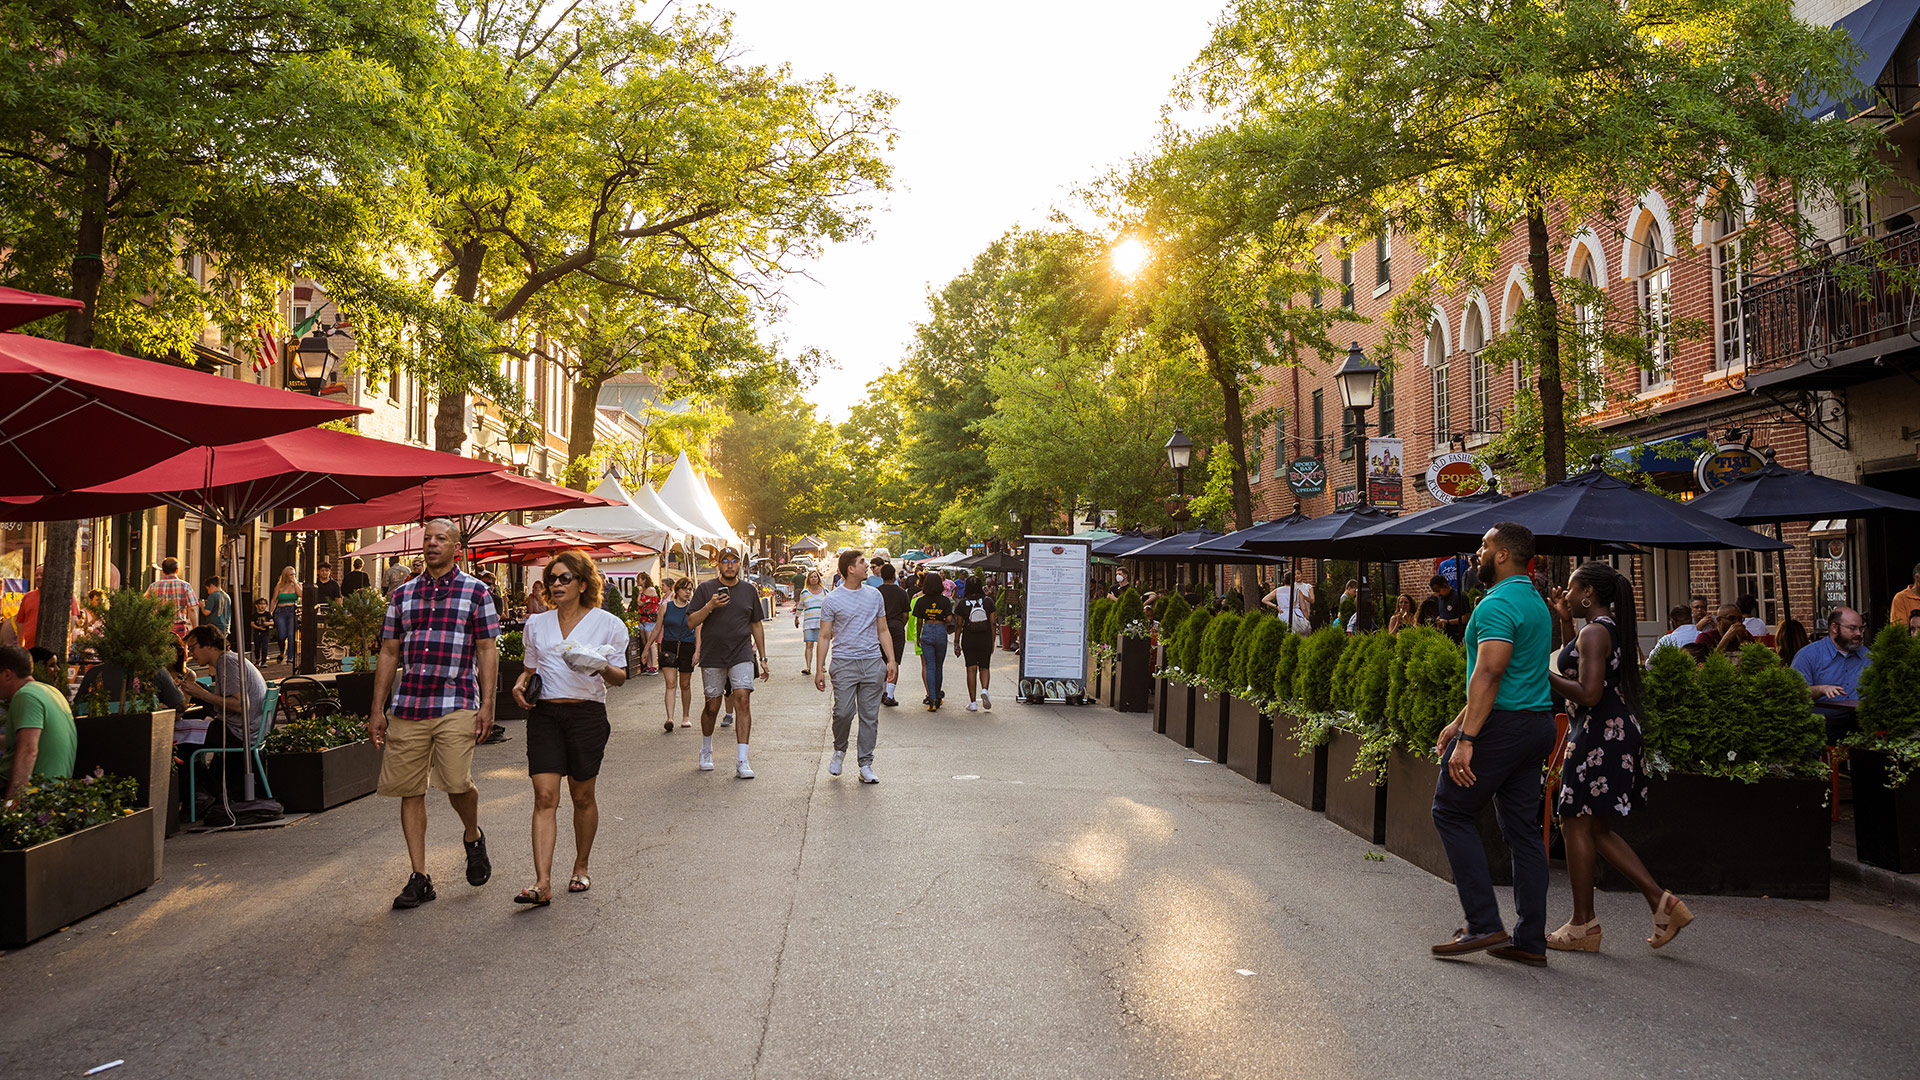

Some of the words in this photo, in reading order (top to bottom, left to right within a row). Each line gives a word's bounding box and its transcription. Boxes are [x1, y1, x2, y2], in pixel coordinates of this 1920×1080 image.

[1432, 458, 1447, 473] OLD
[1448, 453, 1488, 473] FASHIOED
[1714, 456, 1752, 468] FISH
[1823, 560, 1840, 570] PLEASE
[1823, 571, 1835, 580] HOST
[1825, 582, 1835, 591] FOR
